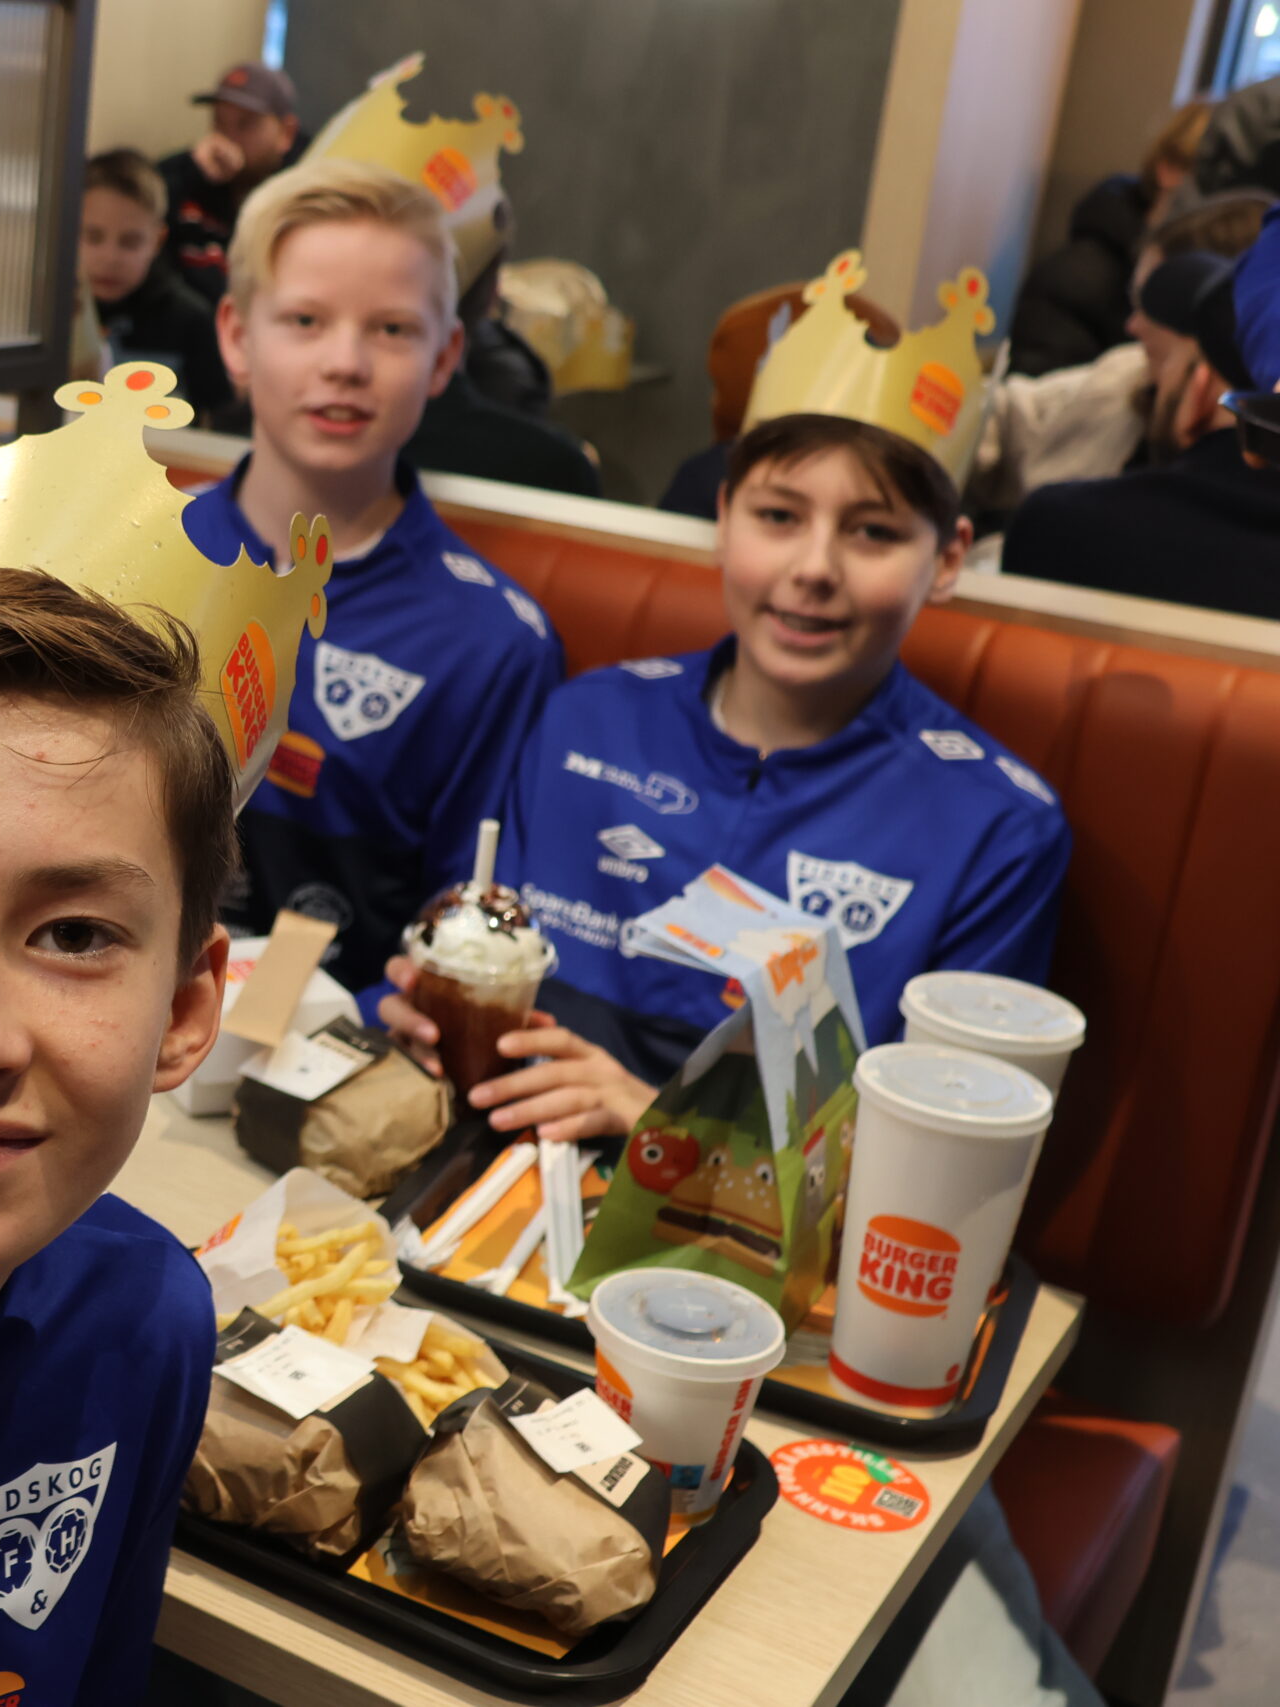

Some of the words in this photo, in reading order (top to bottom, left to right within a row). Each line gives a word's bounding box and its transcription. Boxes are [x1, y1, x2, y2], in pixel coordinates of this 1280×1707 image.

[226, 650, 258, 759] KING
[238, 632, 267, 737] BURGER
[859, 1252, 953, 1302] KING
[864, 1232, 958, 1275] BURGER
[4, 1548, 18, 1579] F
[61, 1526, 77, 1556] H
[31, 1589, 48, 1615] &
